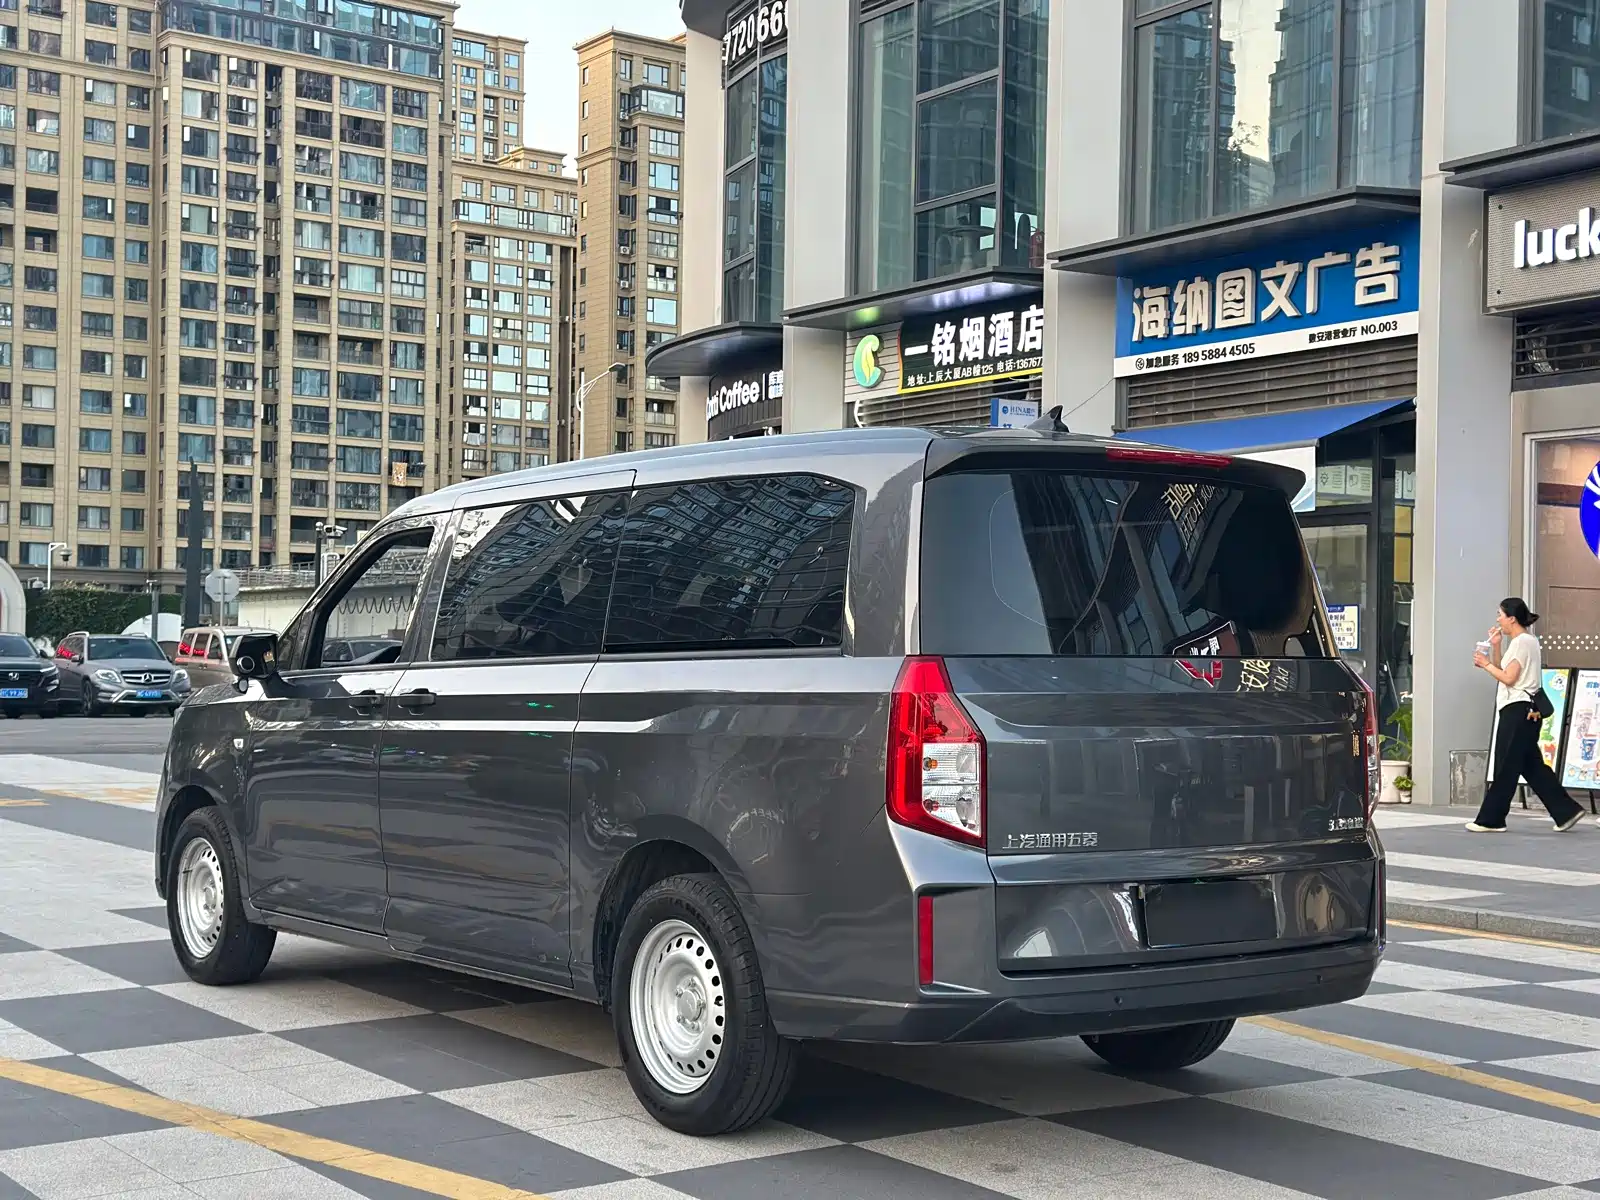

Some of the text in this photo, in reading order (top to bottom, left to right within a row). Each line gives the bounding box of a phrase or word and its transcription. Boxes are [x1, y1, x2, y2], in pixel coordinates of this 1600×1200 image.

[1513, 206, 1600, 269] luck
[1131, 242, 1401, 342] 海纳图文广告
[904, 304, 1044, 367] 一铭烟酒店
[1360, 320, 1398, 336] NO.003
[1145, 342, 1256, 369] 加急服务 189 5884 4505
[720, 379, 760, 413] Coffee
[1002, 832, 1098, 849] 上汽通用五菱
